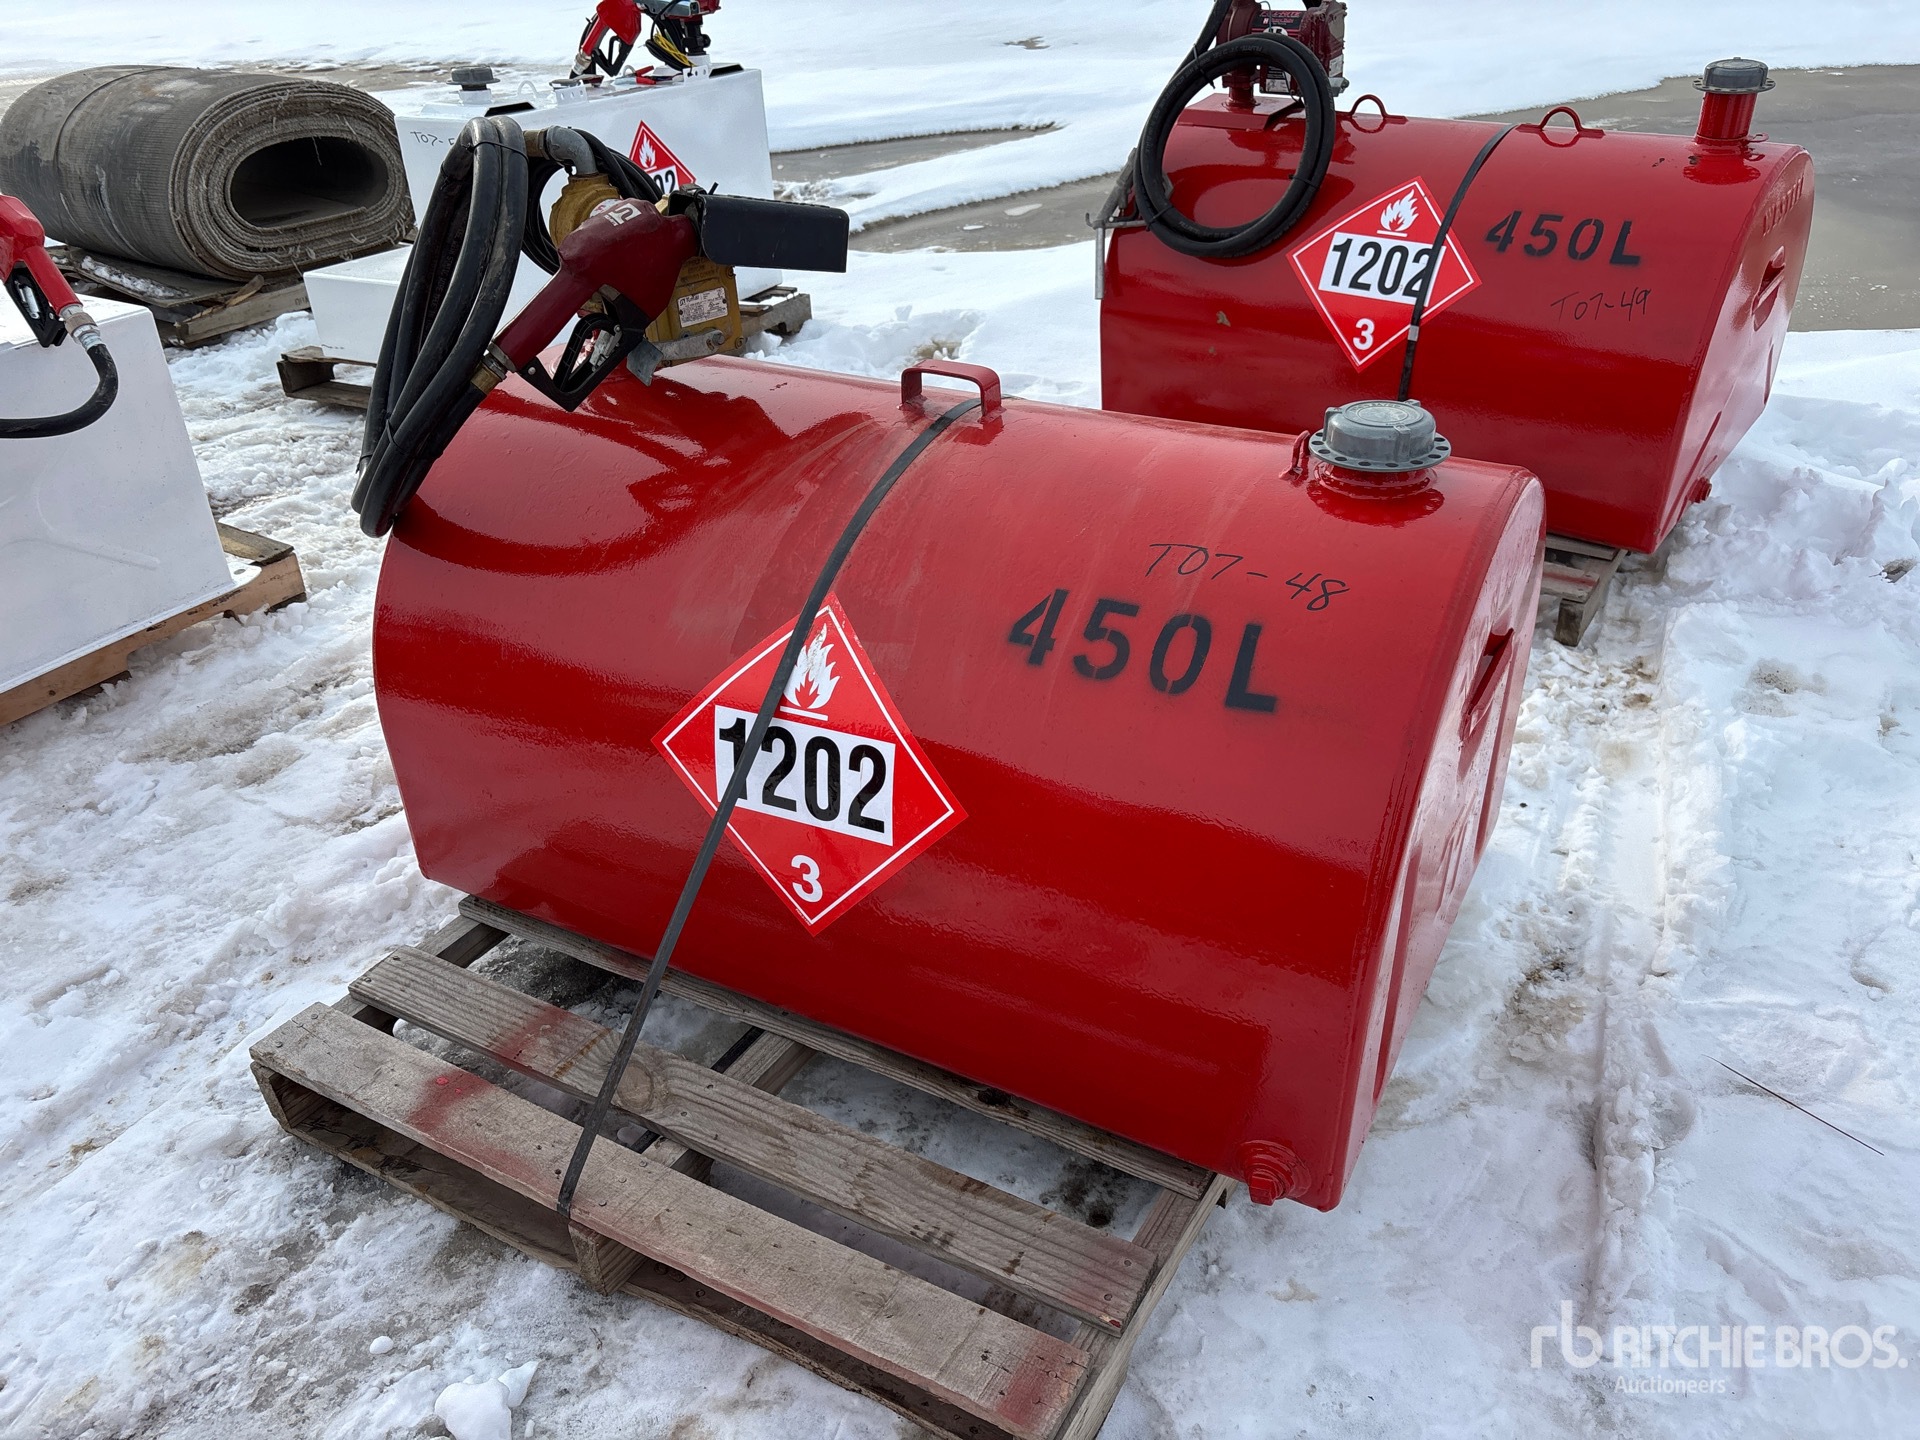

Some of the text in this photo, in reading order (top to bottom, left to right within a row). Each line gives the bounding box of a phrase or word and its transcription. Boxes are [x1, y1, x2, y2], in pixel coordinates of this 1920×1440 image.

[1484, 210, 1641, 265] 450L
[1332, 238, 1432, 299] 1202
[1550, 287, 1652, 322] T07-49
[1353, 318, 1375, 350] 3
[1008, 588, 1278, 713] 450L
[719, 717, 887, 834] 1202
[791, 854, 823, 903] 3
